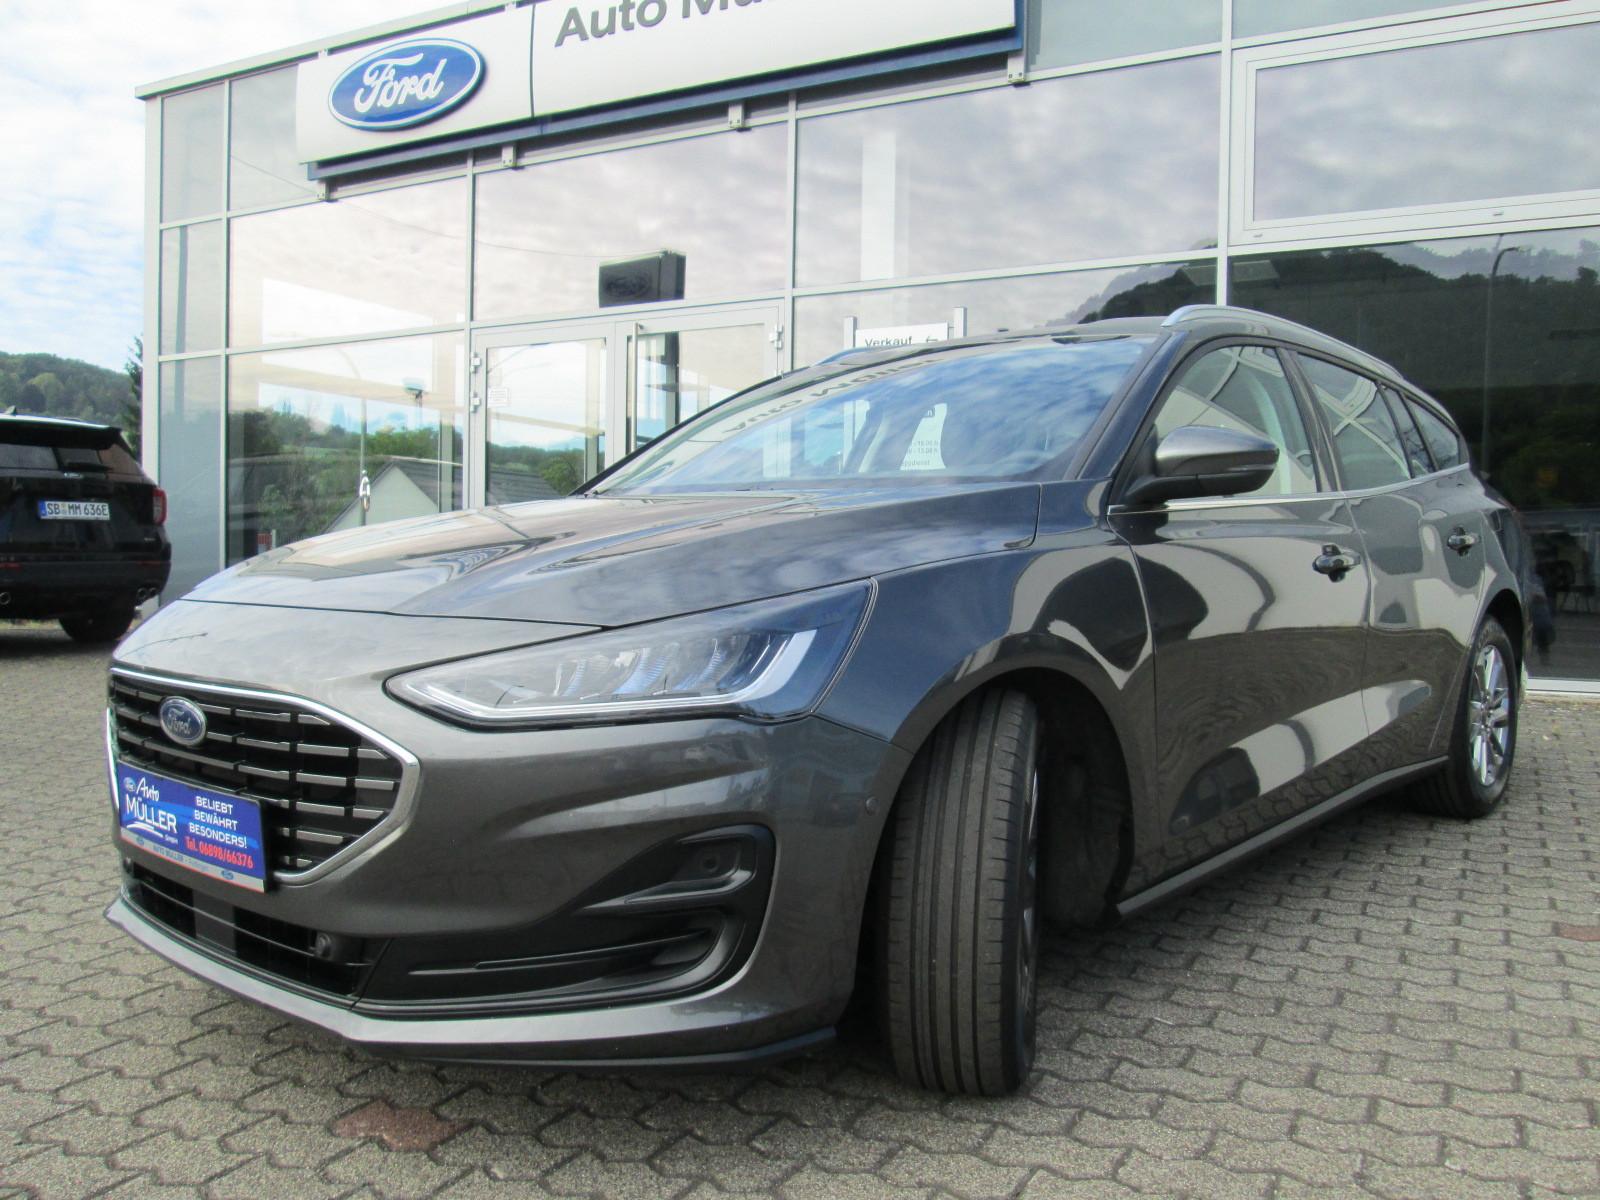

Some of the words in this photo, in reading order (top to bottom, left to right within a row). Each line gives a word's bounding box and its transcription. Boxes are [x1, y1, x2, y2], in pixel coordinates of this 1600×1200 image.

[554, 0, 668, 48] Auto
[353, 53, 448, 113] Ford
[863, 335, 913, 348] Verkauf
[46, 502, 60, 516] SB
[83, 504, 109, 517] 636E
[167, 707, 192, 735] Ford
[136, 776, 160, 802] Auto
[126, 793, 178, 834] MÜLLER
[195, 795, 234, 815] BELIEBT
[193, 809, 239, 831] BEWÄHRT
[188, 821, 249, 849] BESONDERS!
